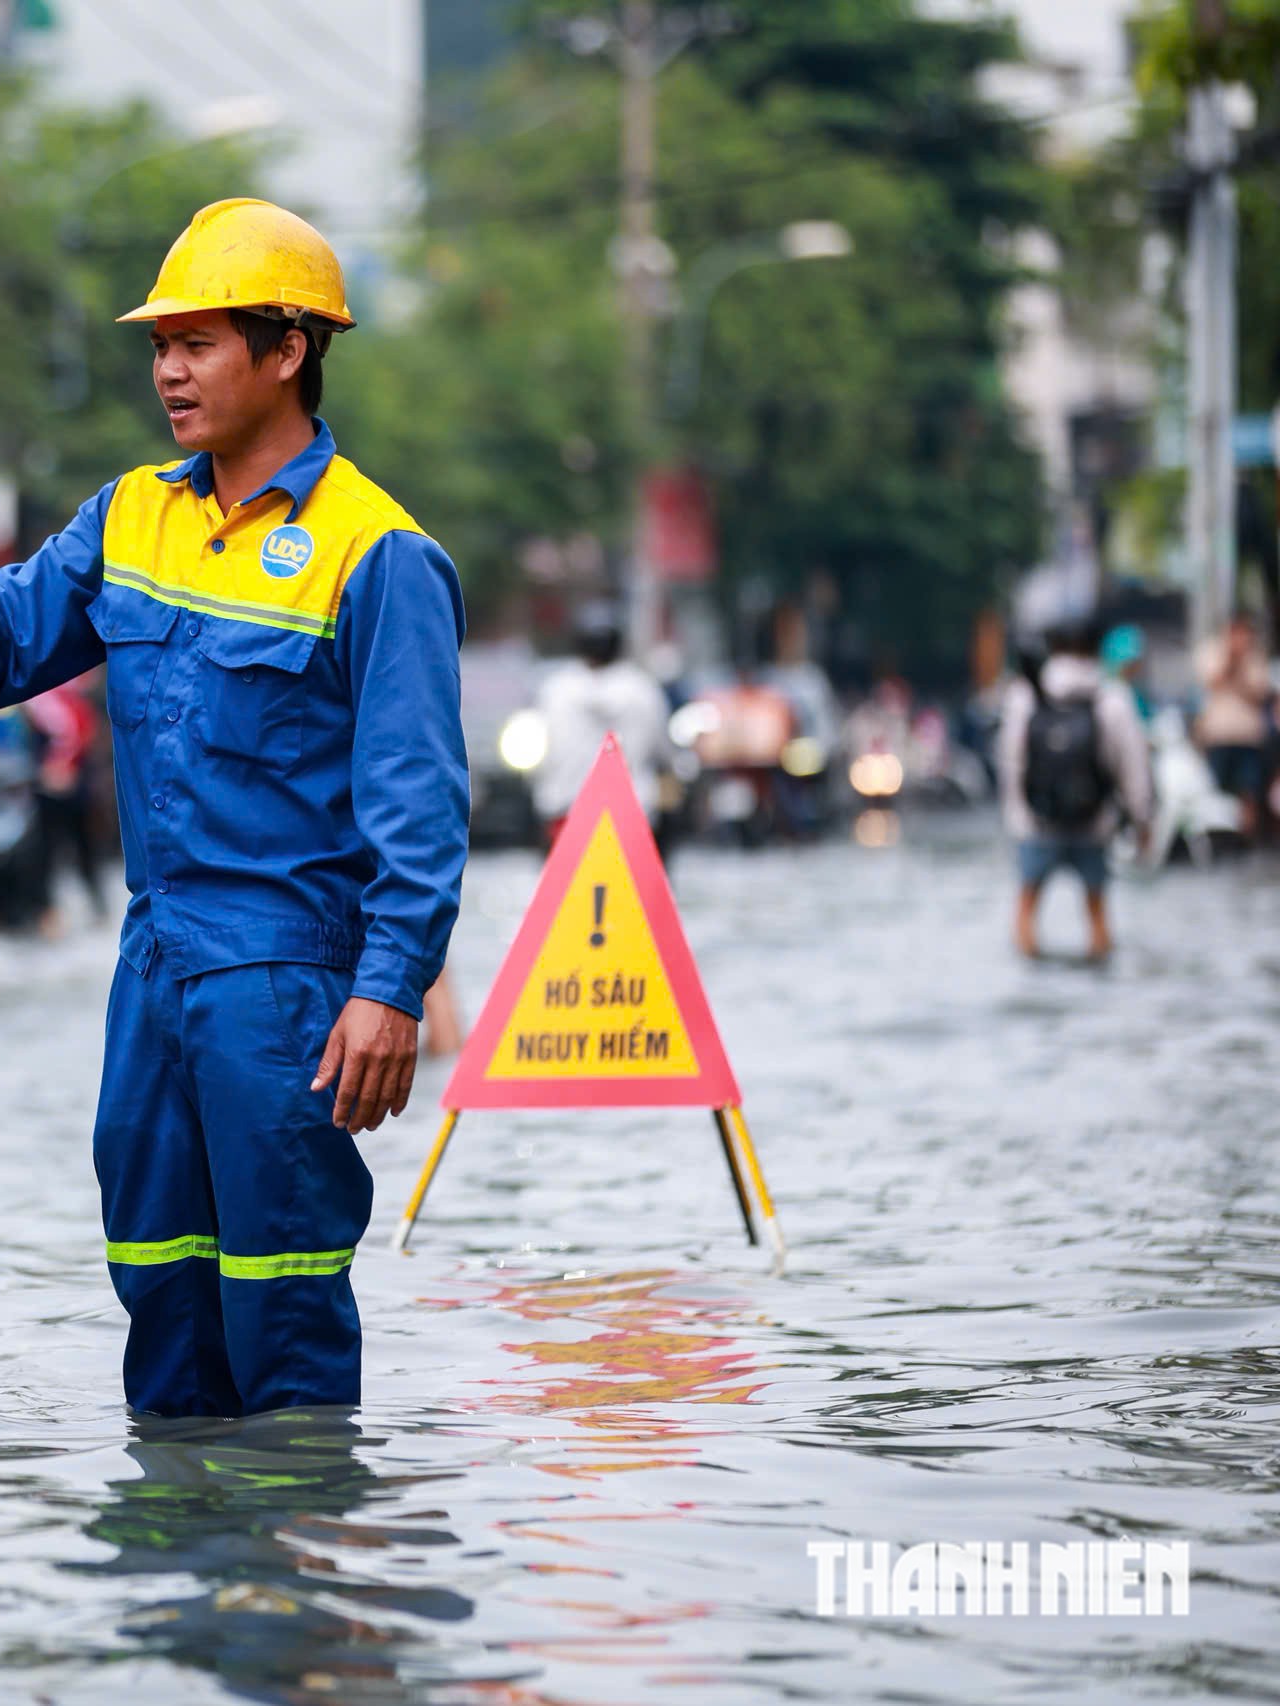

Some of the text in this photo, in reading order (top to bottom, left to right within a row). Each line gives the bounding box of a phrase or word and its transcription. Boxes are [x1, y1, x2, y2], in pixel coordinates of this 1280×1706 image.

[267, 535, 308, 562] UDC
[545, 968, 646, 1006] HỐ SÂU
[516, 1032, 588, 1061] NGUY
